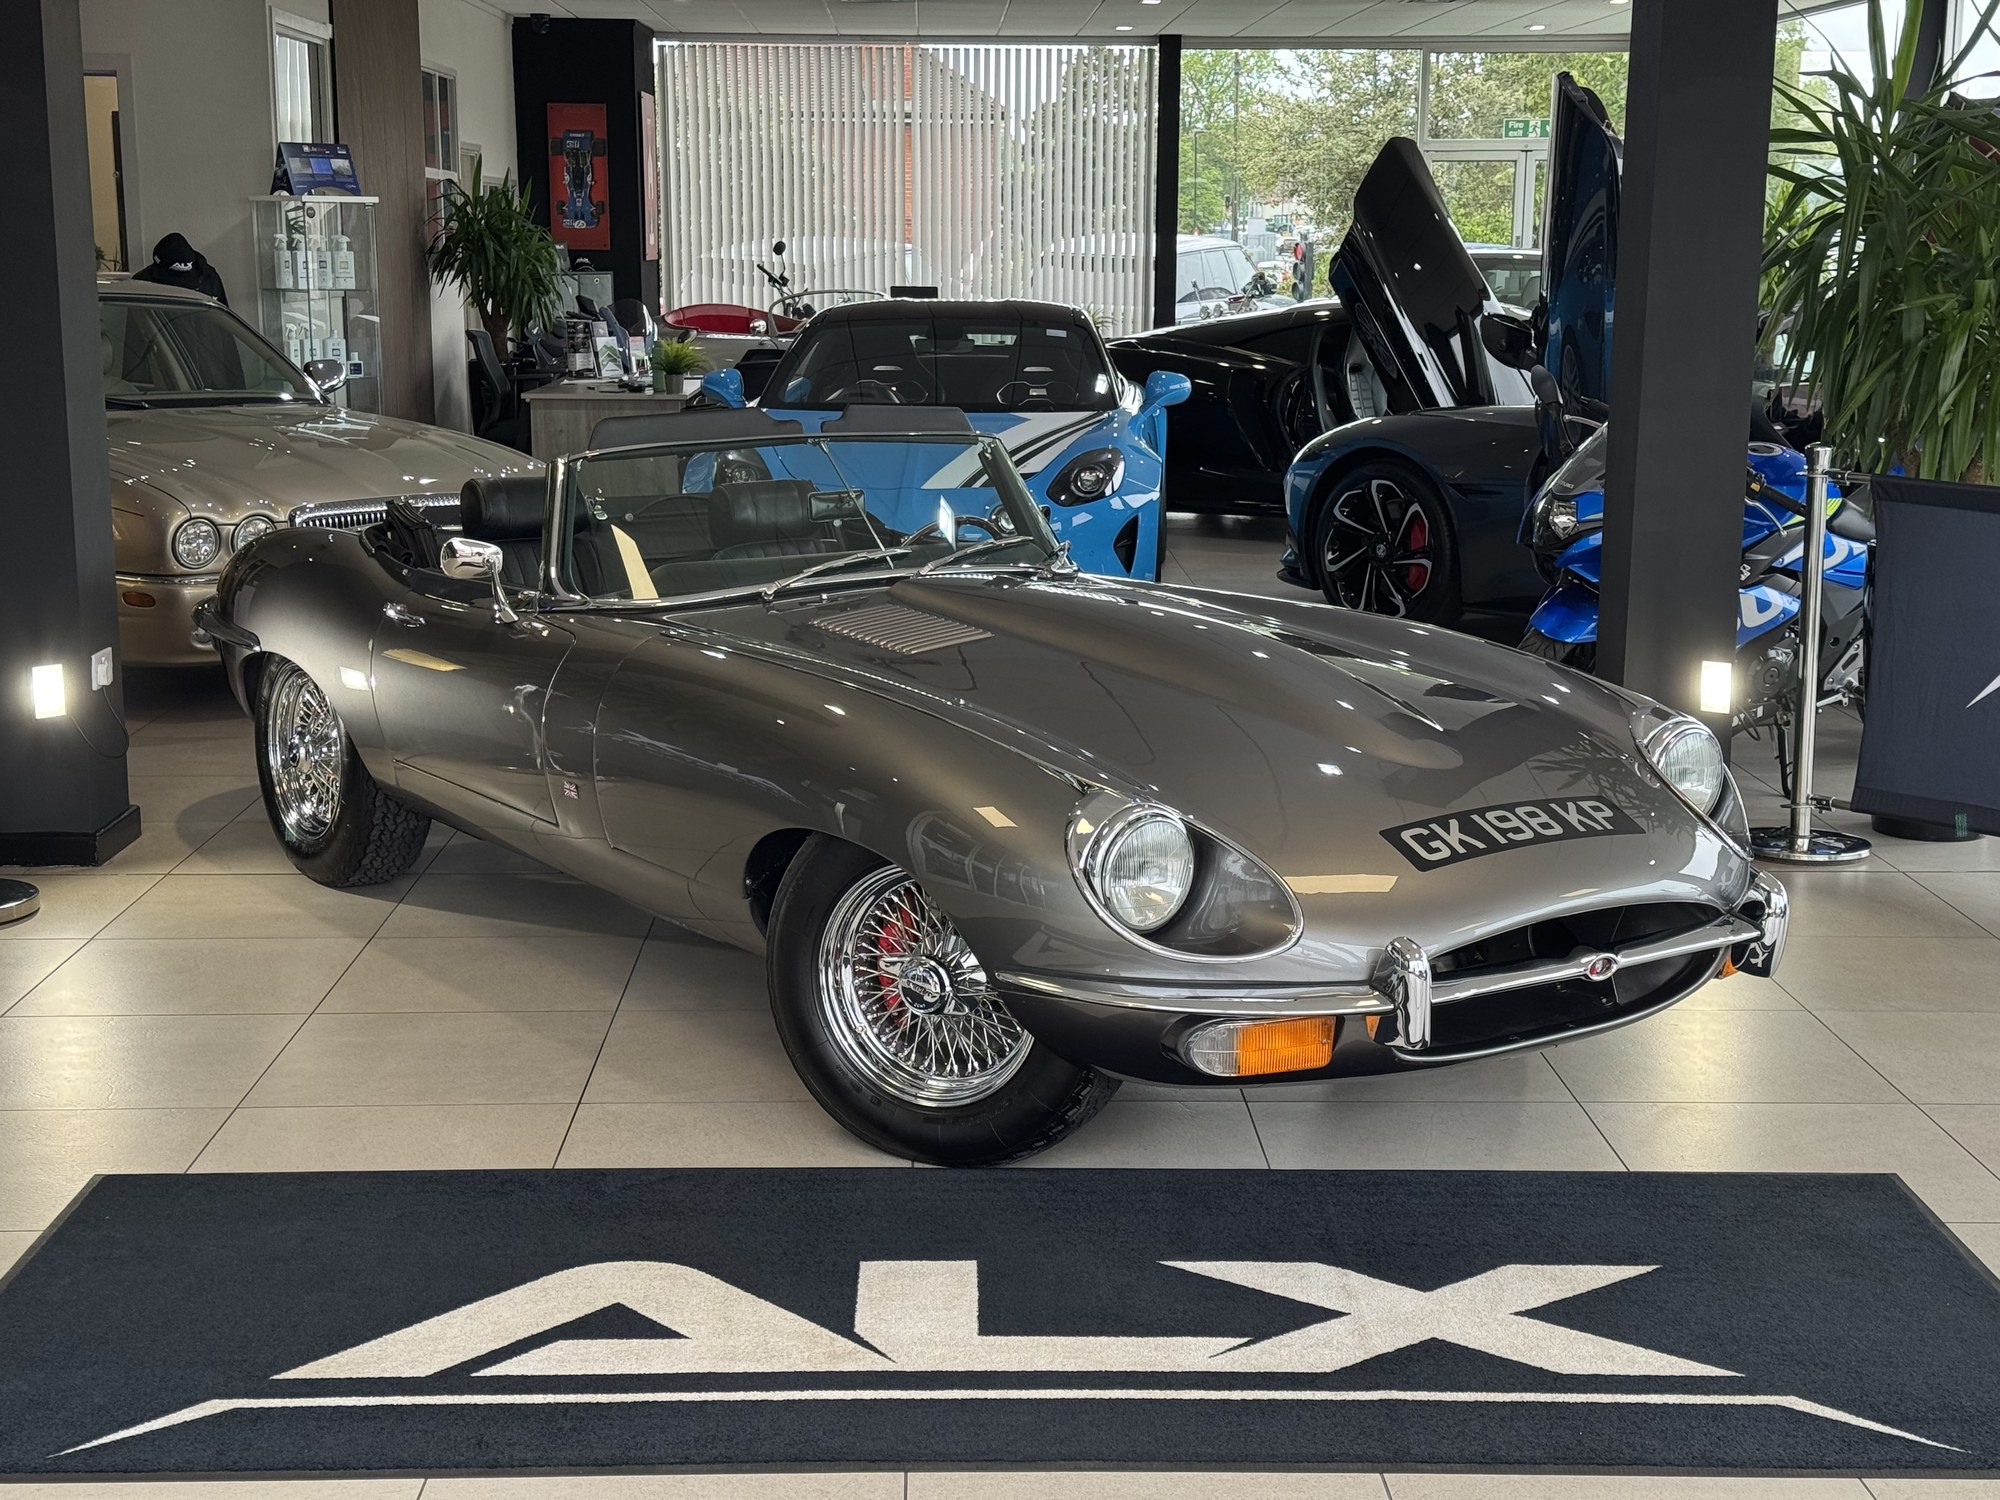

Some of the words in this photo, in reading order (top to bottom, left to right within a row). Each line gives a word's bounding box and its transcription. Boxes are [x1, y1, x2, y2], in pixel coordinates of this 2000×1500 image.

[1508, 129, 1523, 137] exit
[1509, 121, 1524, 129] Fire
[1400, 818, 1488, 861] GK
[1470, 806, 1564, 845] 198
[1549, 800, 1615, 832] KP
[269, 1259, 1746, 1380] ALX
